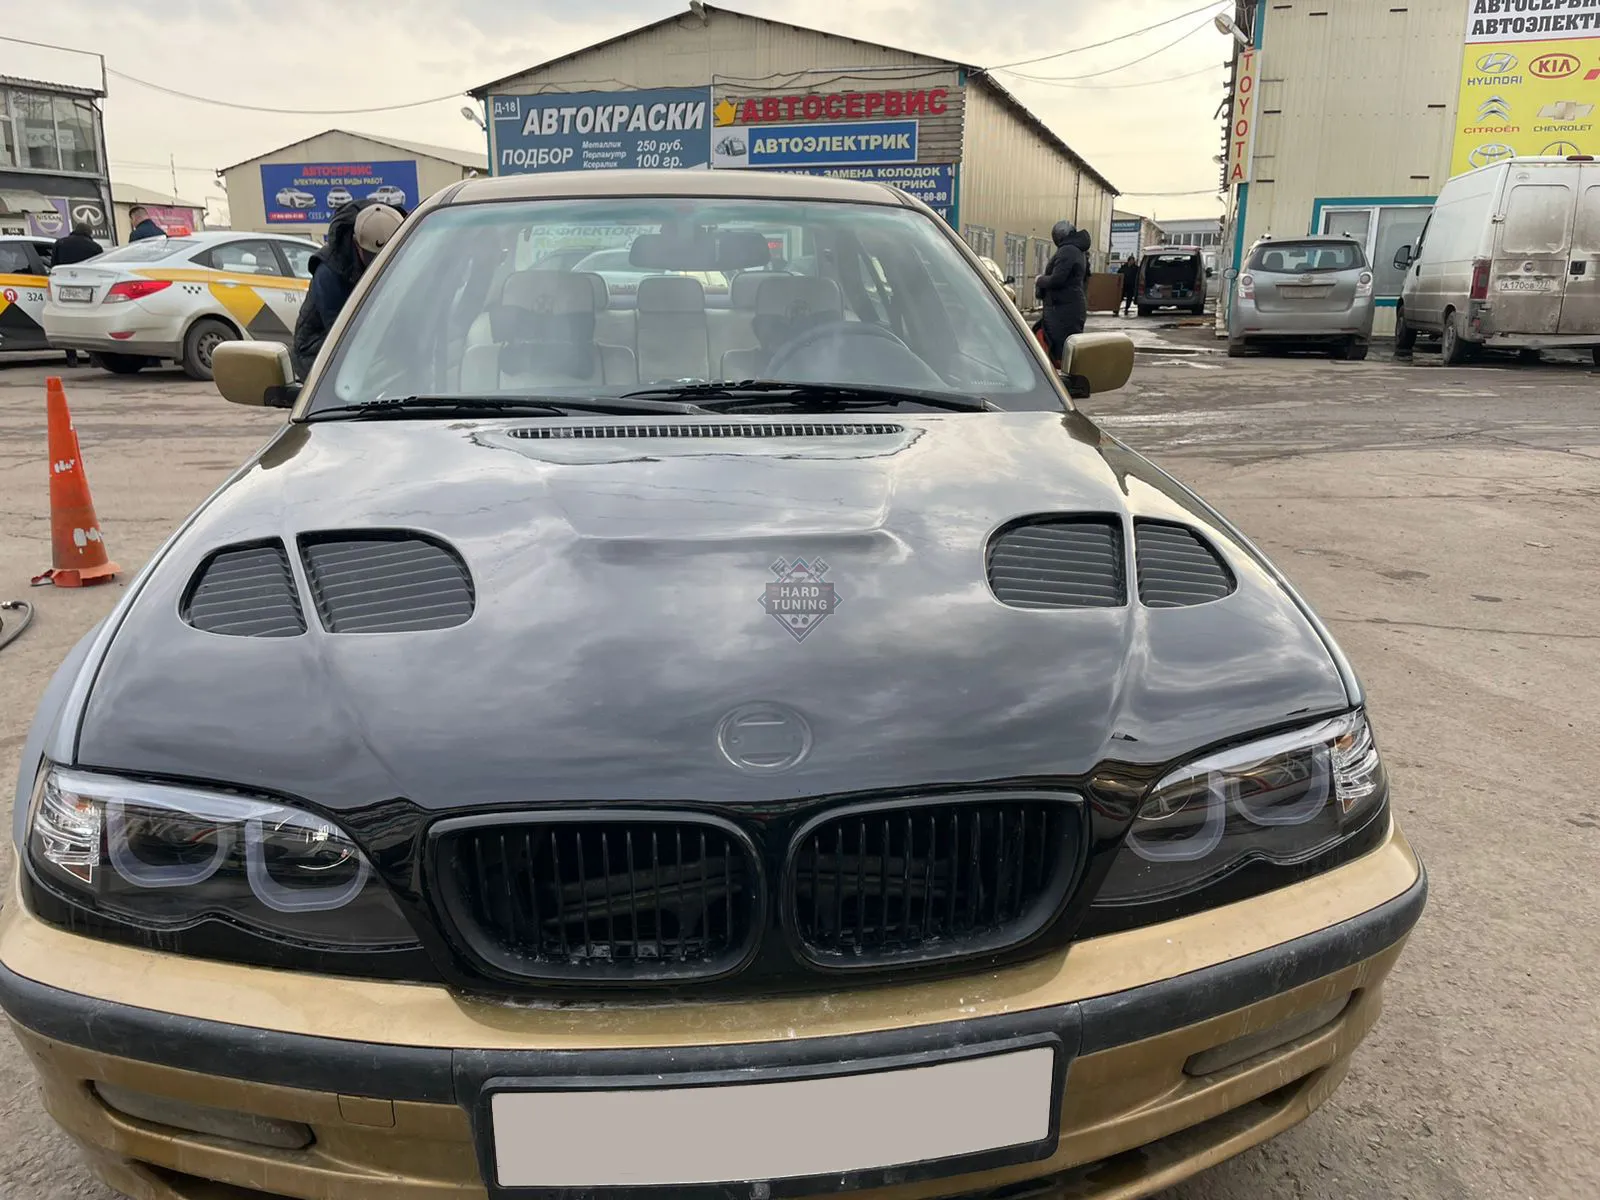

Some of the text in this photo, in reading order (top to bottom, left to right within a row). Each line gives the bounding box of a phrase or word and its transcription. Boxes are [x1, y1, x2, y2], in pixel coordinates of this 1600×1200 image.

[1473, 0, 1600, 14] АВТОСЕРВ
[1538, 59, 1571, 73] KIA
[1467, 75, 1523, 86] HYUNDAI
[494, 101, 516, 114] Д-18
[741, 89, 949, 123] АВТОСЕРВИС
[522, 101, 706, 136] АВТОКРАСКИ
[1231, 52, 1254, 180] TOYOTA
[1533, 124, 1593, 132] CHEVROLET
[637, 139, 684, 153] 250 руб.
[753, 133, 911, 154] АВТОЭЛЕКТРИК
[502, 147, 574, 168] ПОДБОР
[636, 154, 683, 169] 100 гр.
[824, 168, 874, 178] ЗАМЕНА
[878, 167, 941, 178] КОЛОДОК
[27, 292, 43, 302] 324
